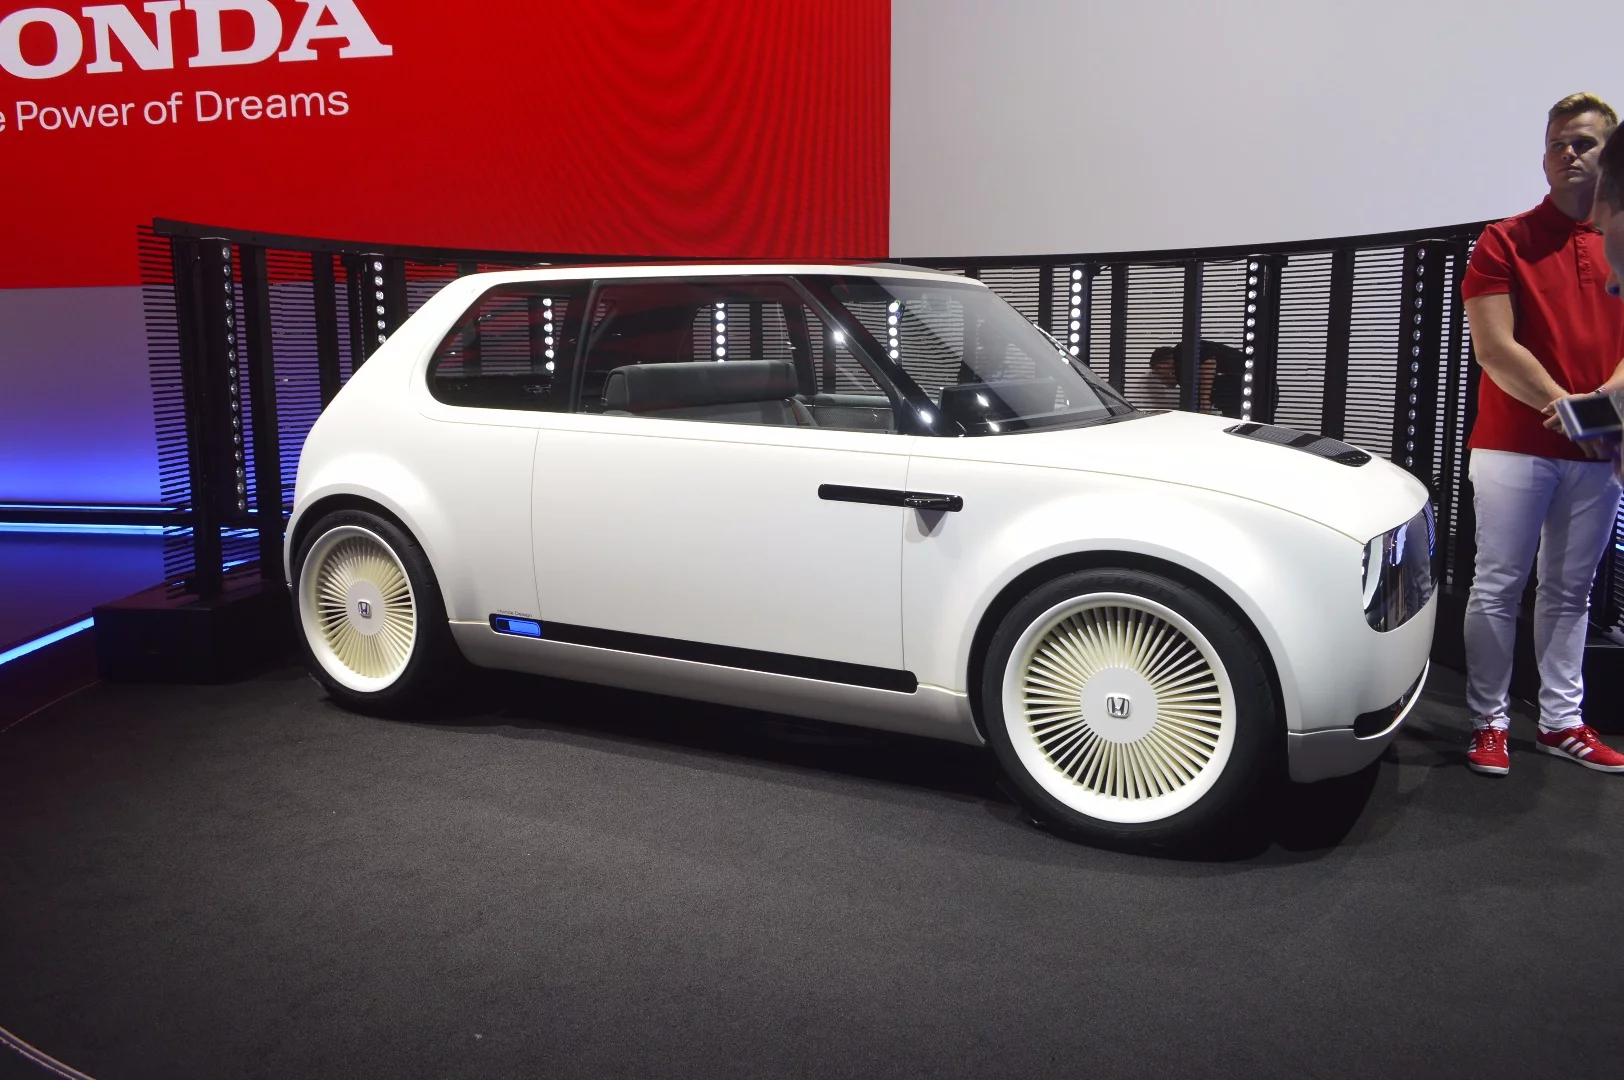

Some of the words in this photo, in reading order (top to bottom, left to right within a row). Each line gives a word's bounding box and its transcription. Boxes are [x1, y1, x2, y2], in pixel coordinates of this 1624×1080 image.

[16, 100, 135, 131] Power
[143, 92, 183, 125] of
[195, 90, 350, 123] Dreams
